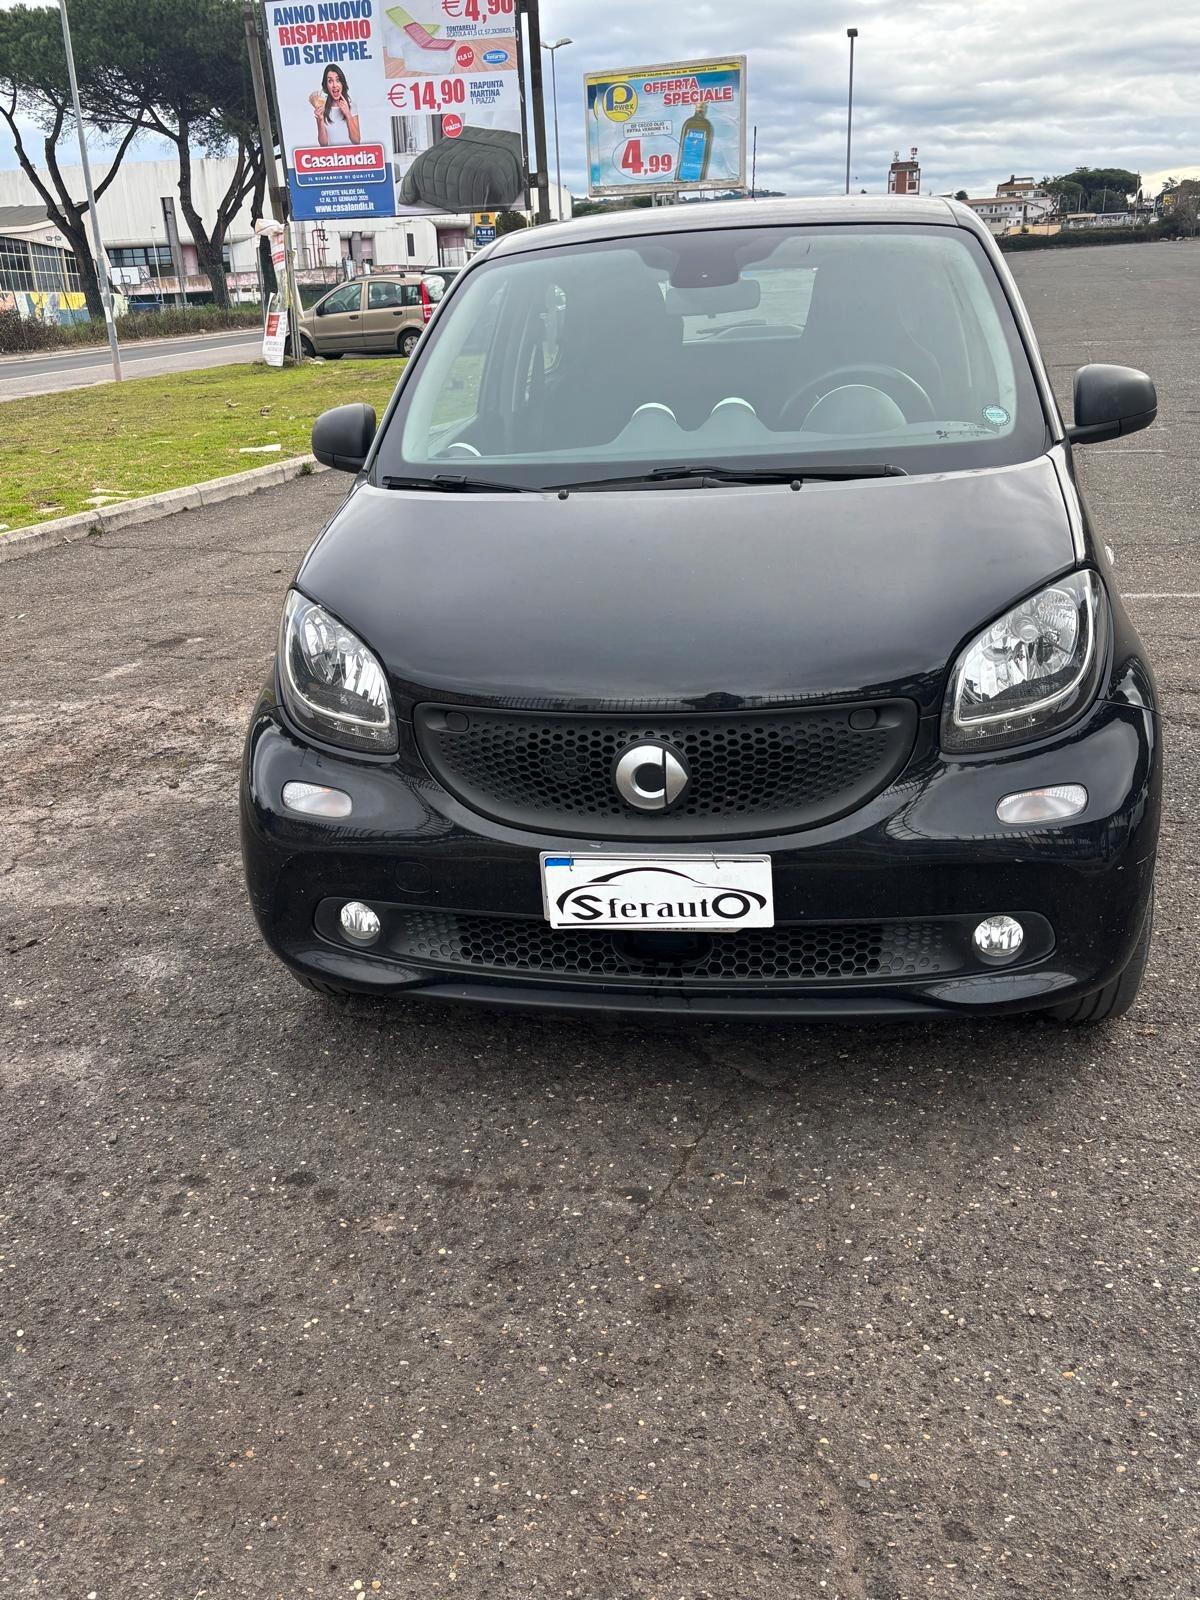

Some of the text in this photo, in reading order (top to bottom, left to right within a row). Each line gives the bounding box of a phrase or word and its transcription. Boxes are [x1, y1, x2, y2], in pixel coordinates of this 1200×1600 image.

[274, 0, 372, 26] ANNO NUOVO
[278, 19, 371, 46] RISPARMIO
[446, 24, 477, 32] TONTARELLI
[282, 41, 372, 66] DI SEMPRE.
[469, 80, 504, 90] TRAPUNTA
[470, 89, 501, 98] MARTINA
[643, 78, 699, 94] OFFERTA
[606, 85, 634, 111] Pewex
[663, 87, 732, 106] SPECIALE
[301, 150, 377, 168] Casalandia
[621, 139, 672, 176] 4,99
[315, 201, 375, 213] www.casalandia.it
